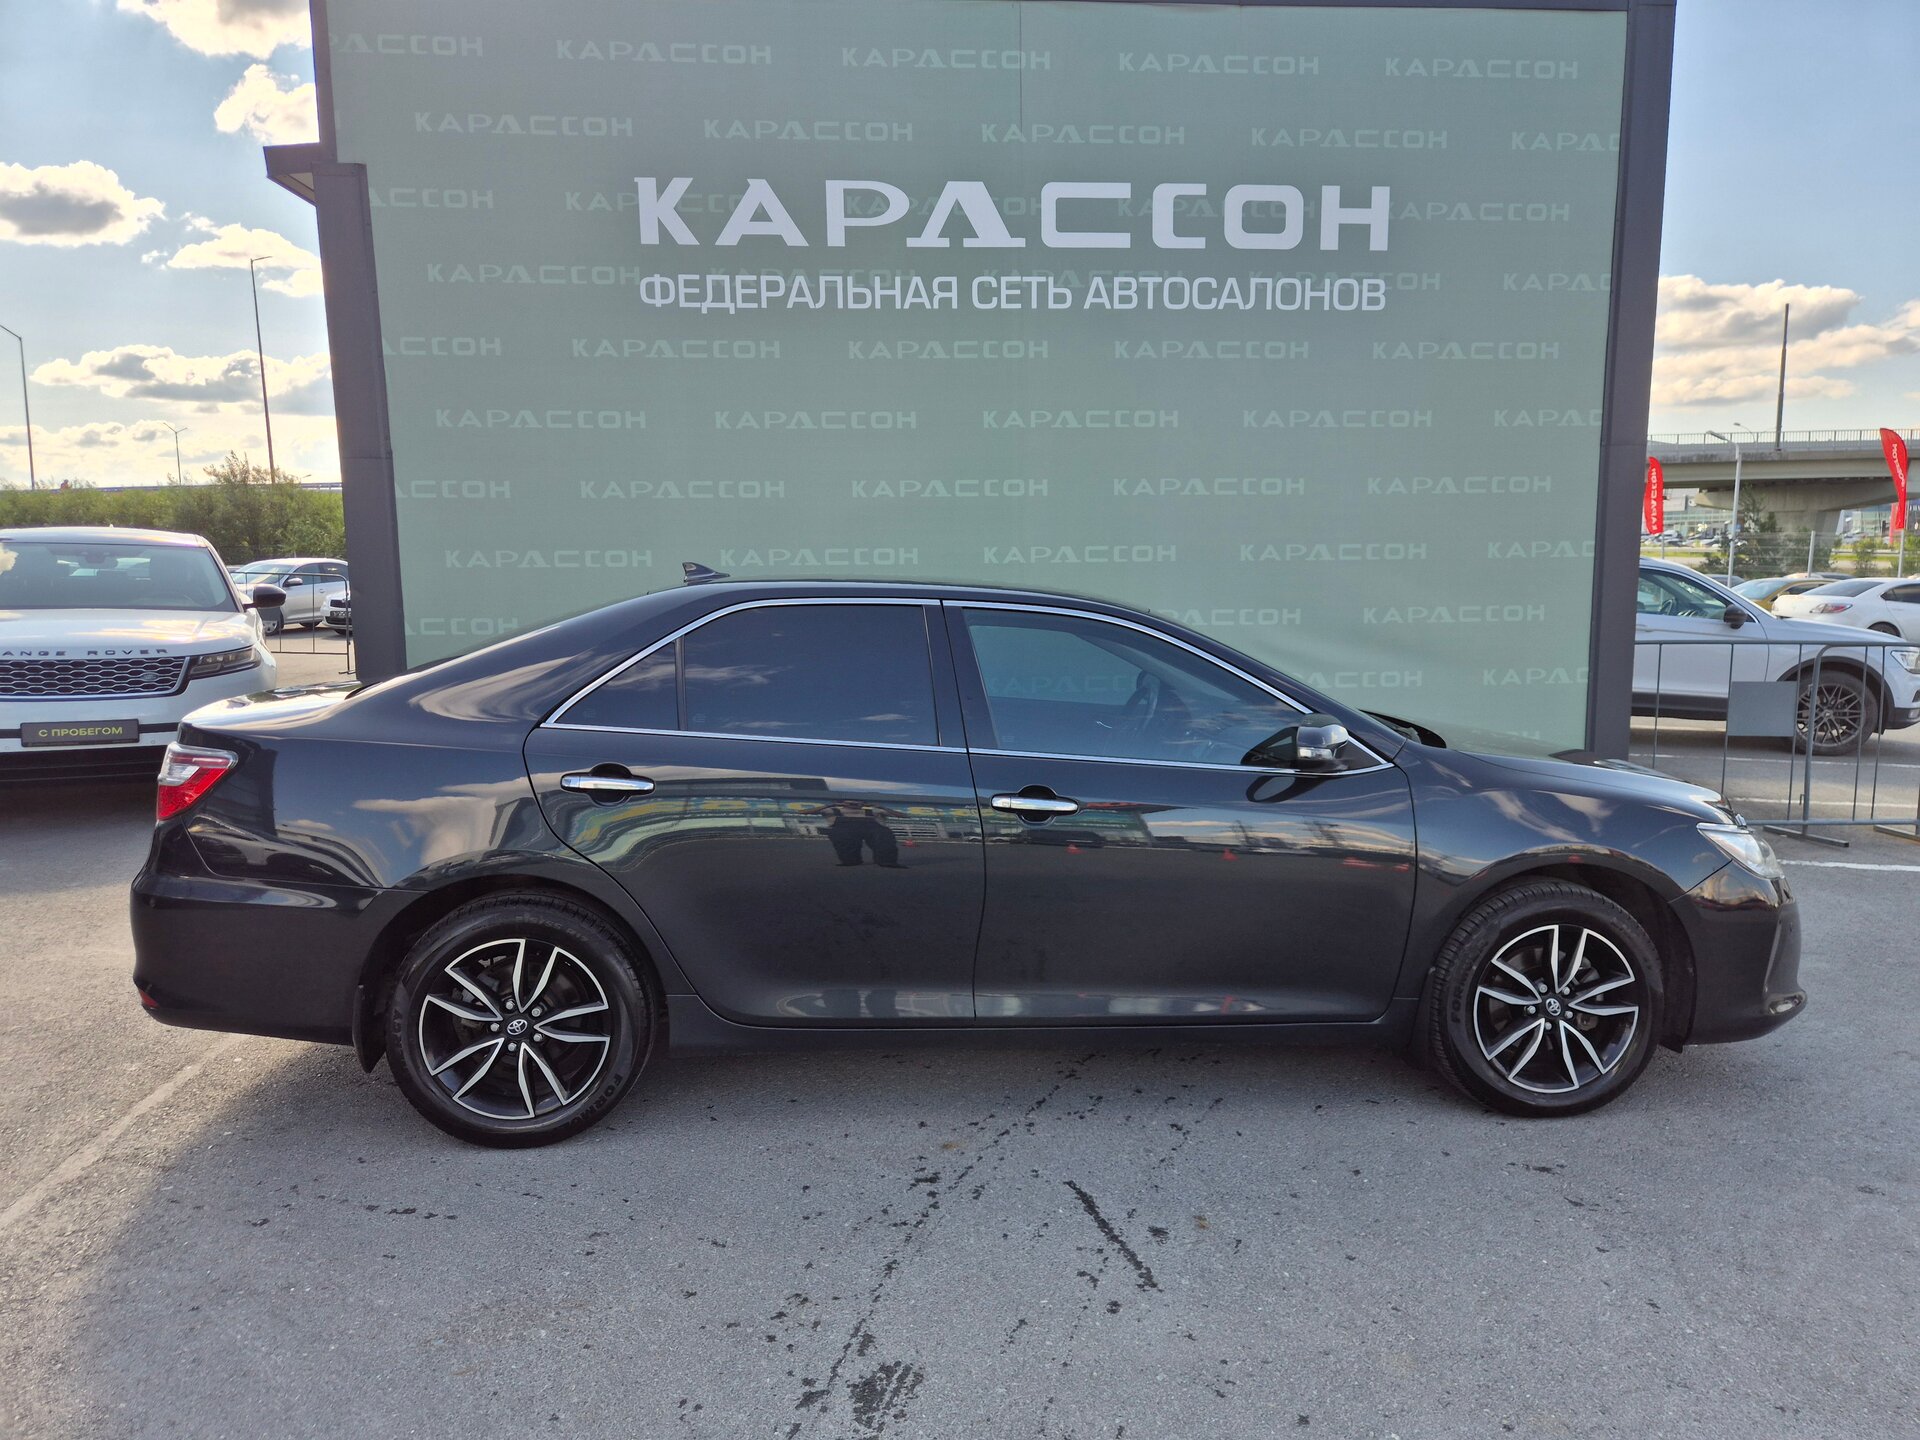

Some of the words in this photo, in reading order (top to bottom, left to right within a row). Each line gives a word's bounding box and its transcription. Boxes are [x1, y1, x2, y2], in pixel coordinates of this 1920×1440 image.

[639, 273, 958, 315] ФЕДЕРАЛЬНАЯ
[971, 276, 1073, 310] СЕТЬ
[1083, 277, 1386, 311] АВТОСАЛОНОВ
[87, 648, 169, 657] ROVER
[38, 728, 49, 738] С
[51, 726, 124, 738] ПРОБЕГОМ
